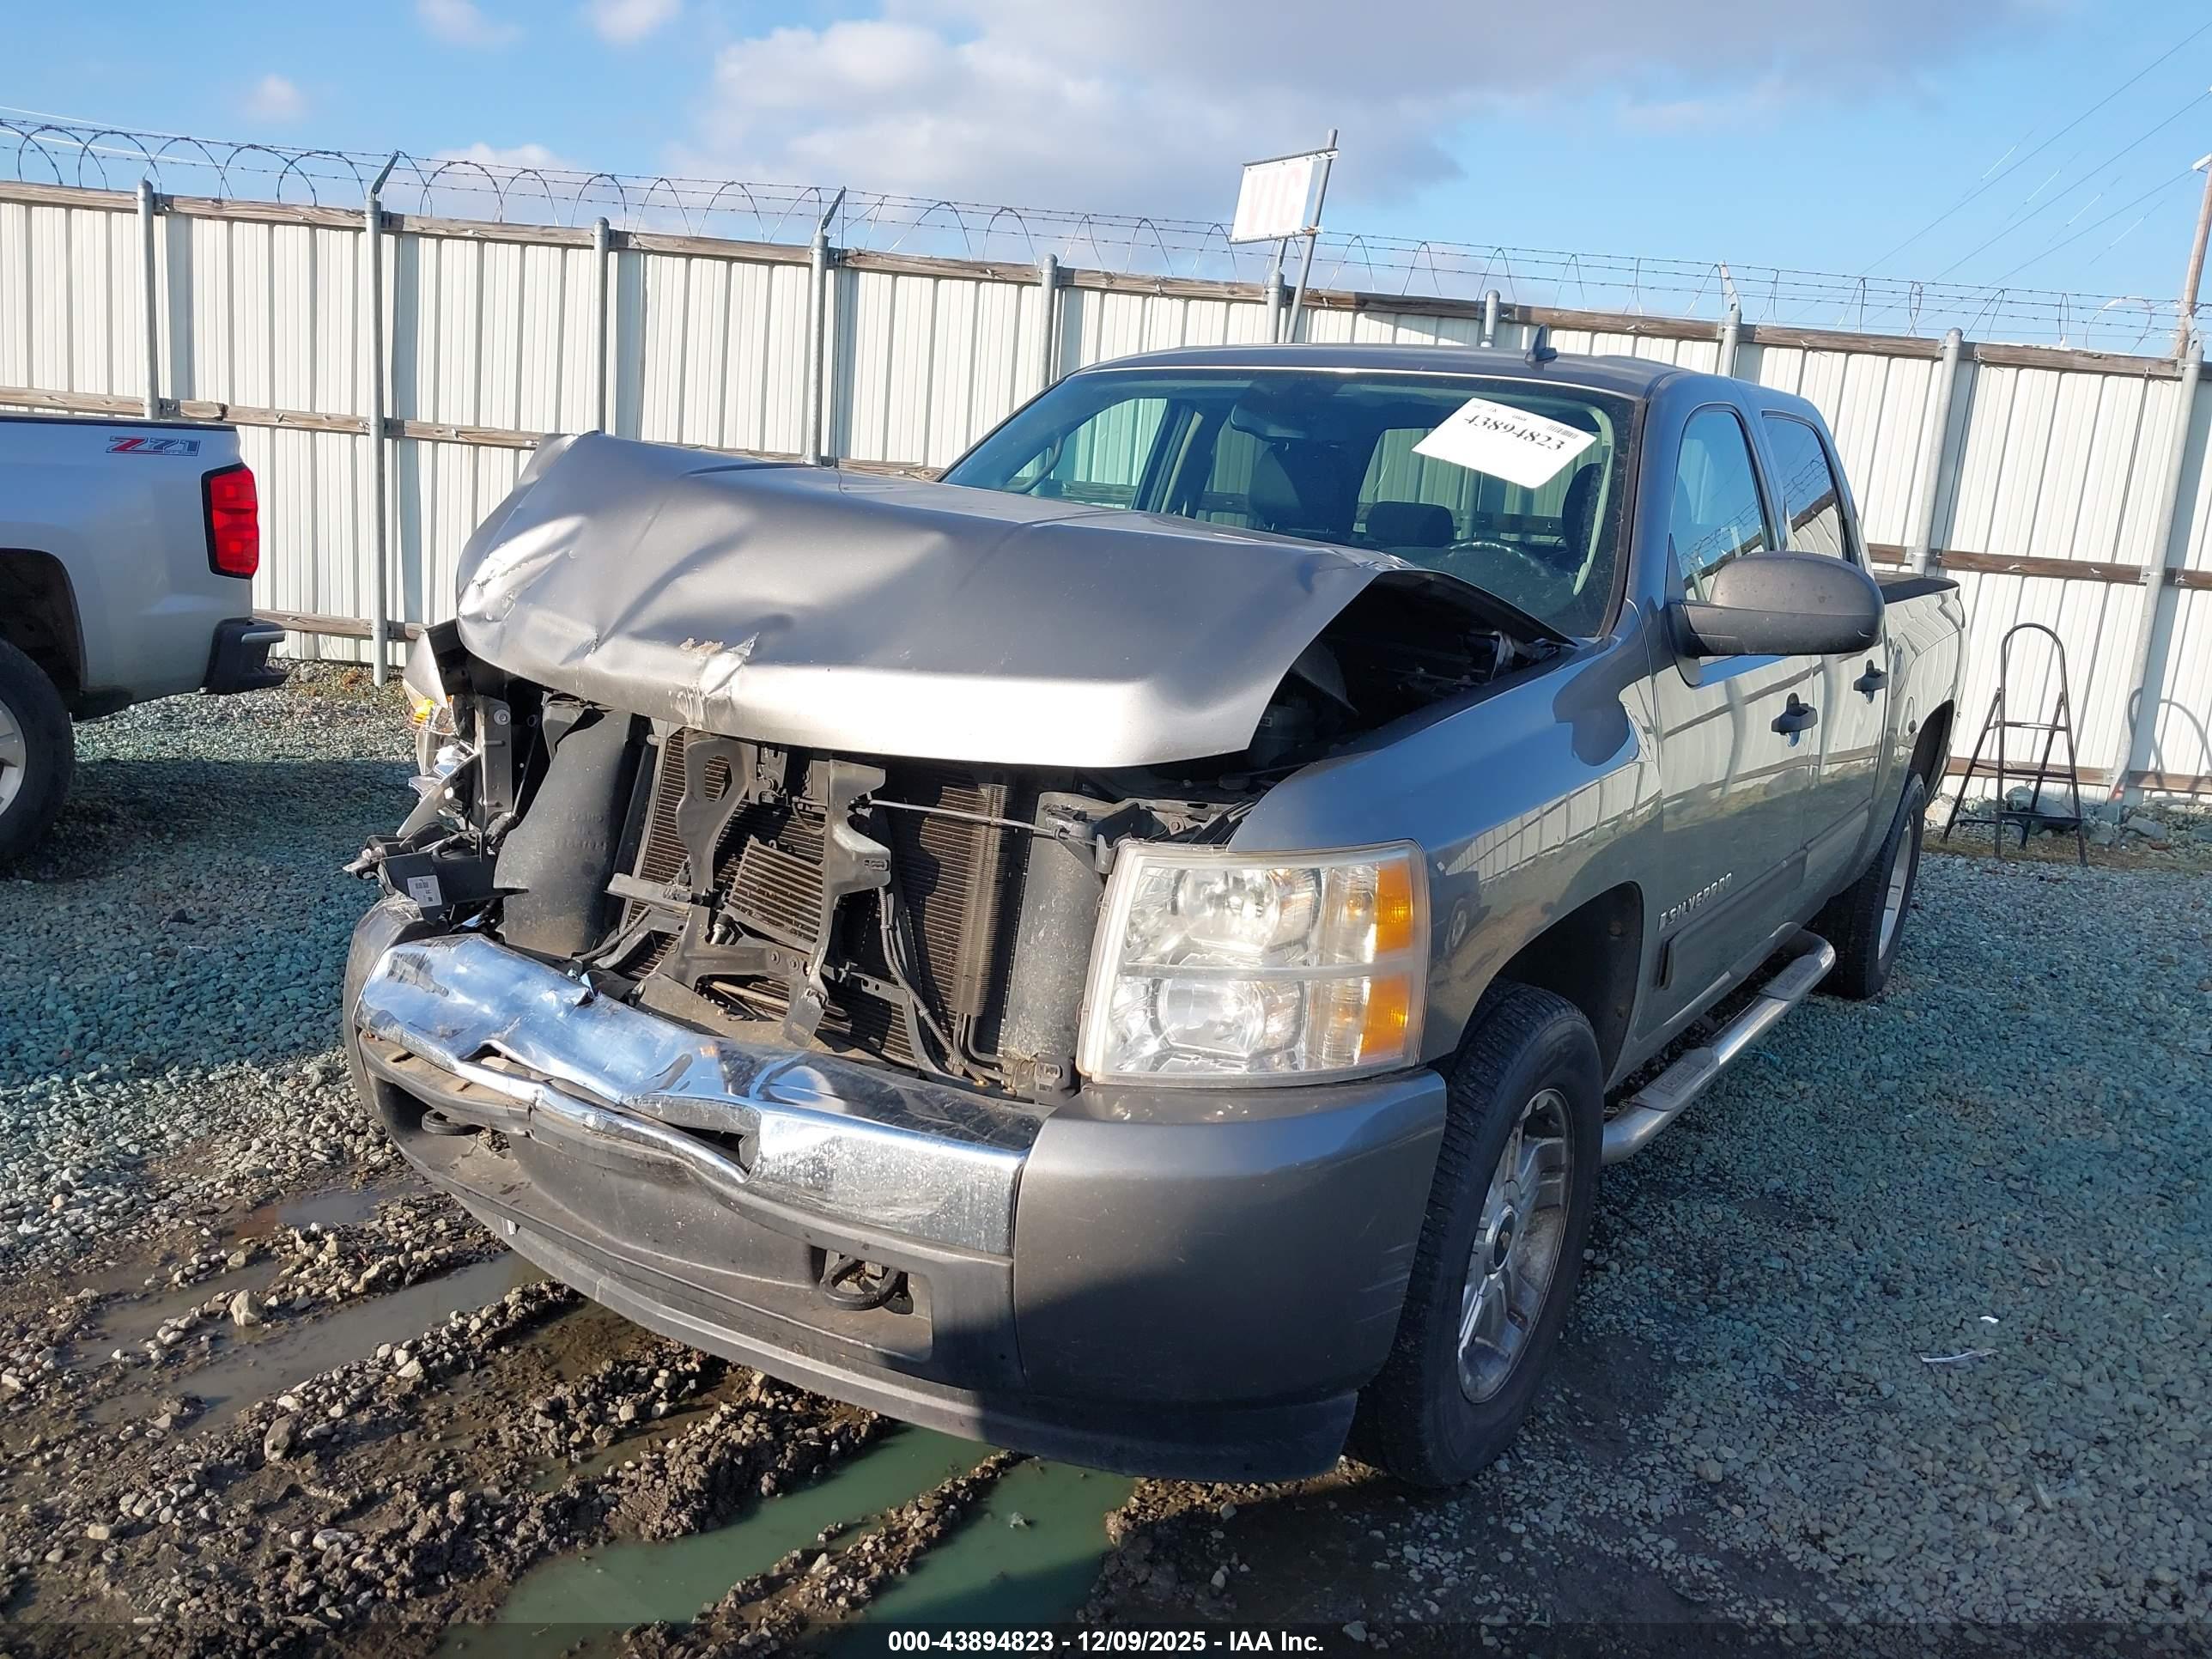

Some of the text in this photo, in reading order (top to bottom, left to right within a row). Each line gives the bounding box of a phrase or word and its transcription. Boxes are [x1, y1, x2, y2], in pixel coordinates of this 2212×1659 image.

[106, 435, 201, 456] Z71
[1464, 414, 1565, 451] 43894823
[1668, 872, 1732, 925] SILVERADO
